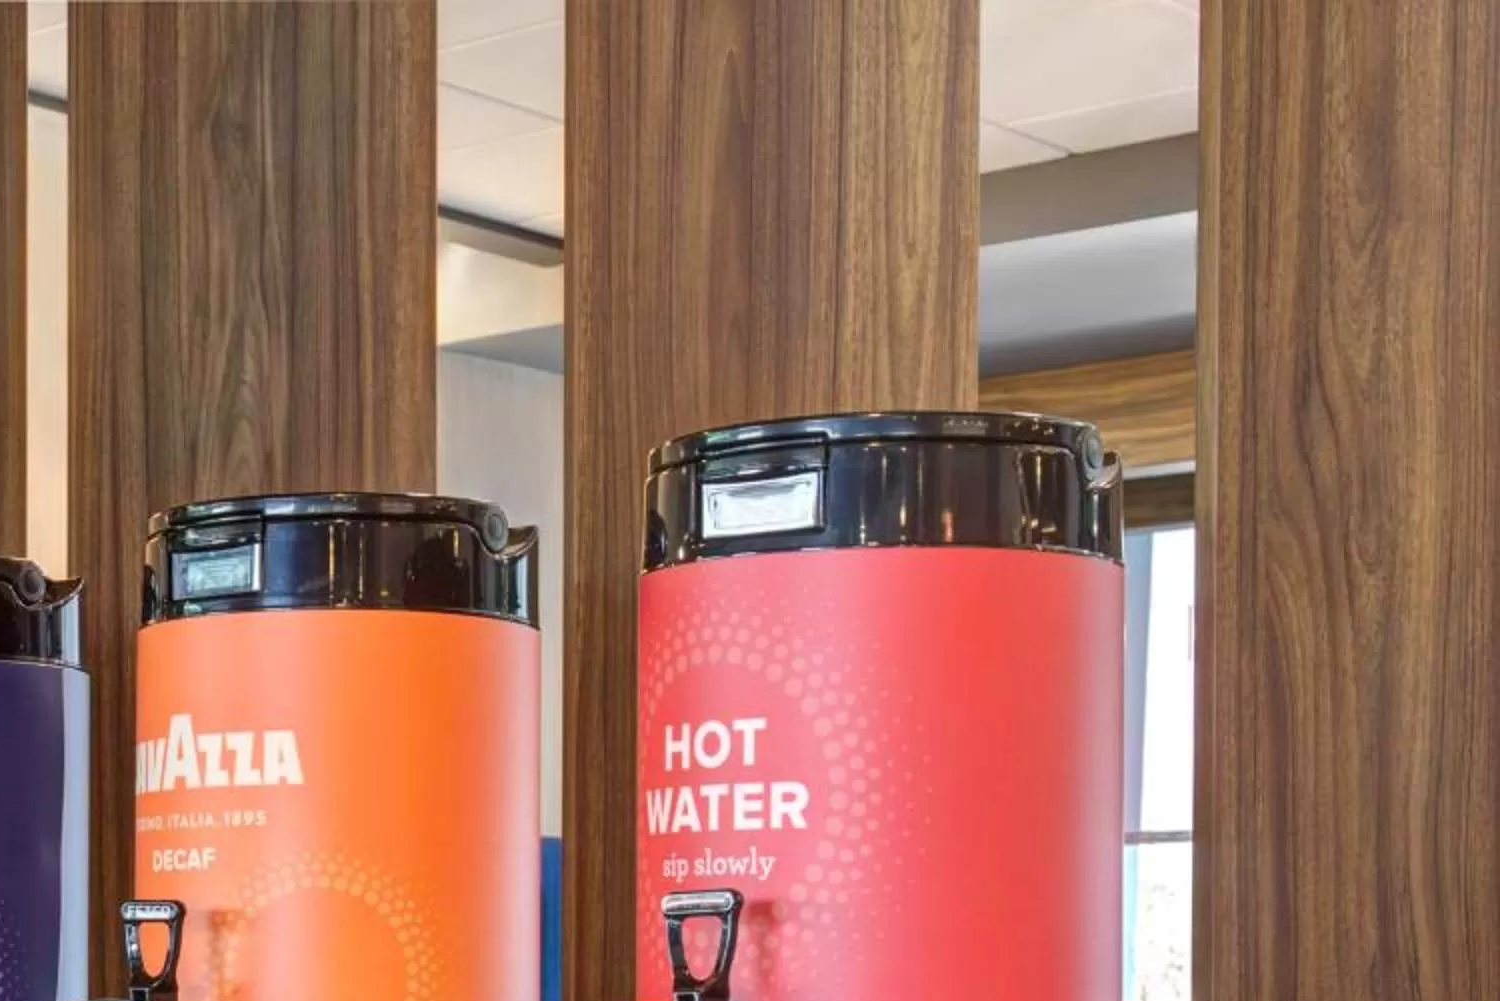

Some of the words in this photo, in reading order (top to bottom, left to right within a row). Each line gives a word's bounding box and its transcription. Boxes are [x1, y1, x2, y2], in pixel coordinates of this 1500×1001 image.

[136, 713, 304, 795] AVAZZA
[664, 717, 767, 771] HOT
[646, 780, 810, 836] WATER
[152, 847, 217, 872] DECAF
[662, 852, 689, 881] sip
[694, 846, 777, 881] slowly
